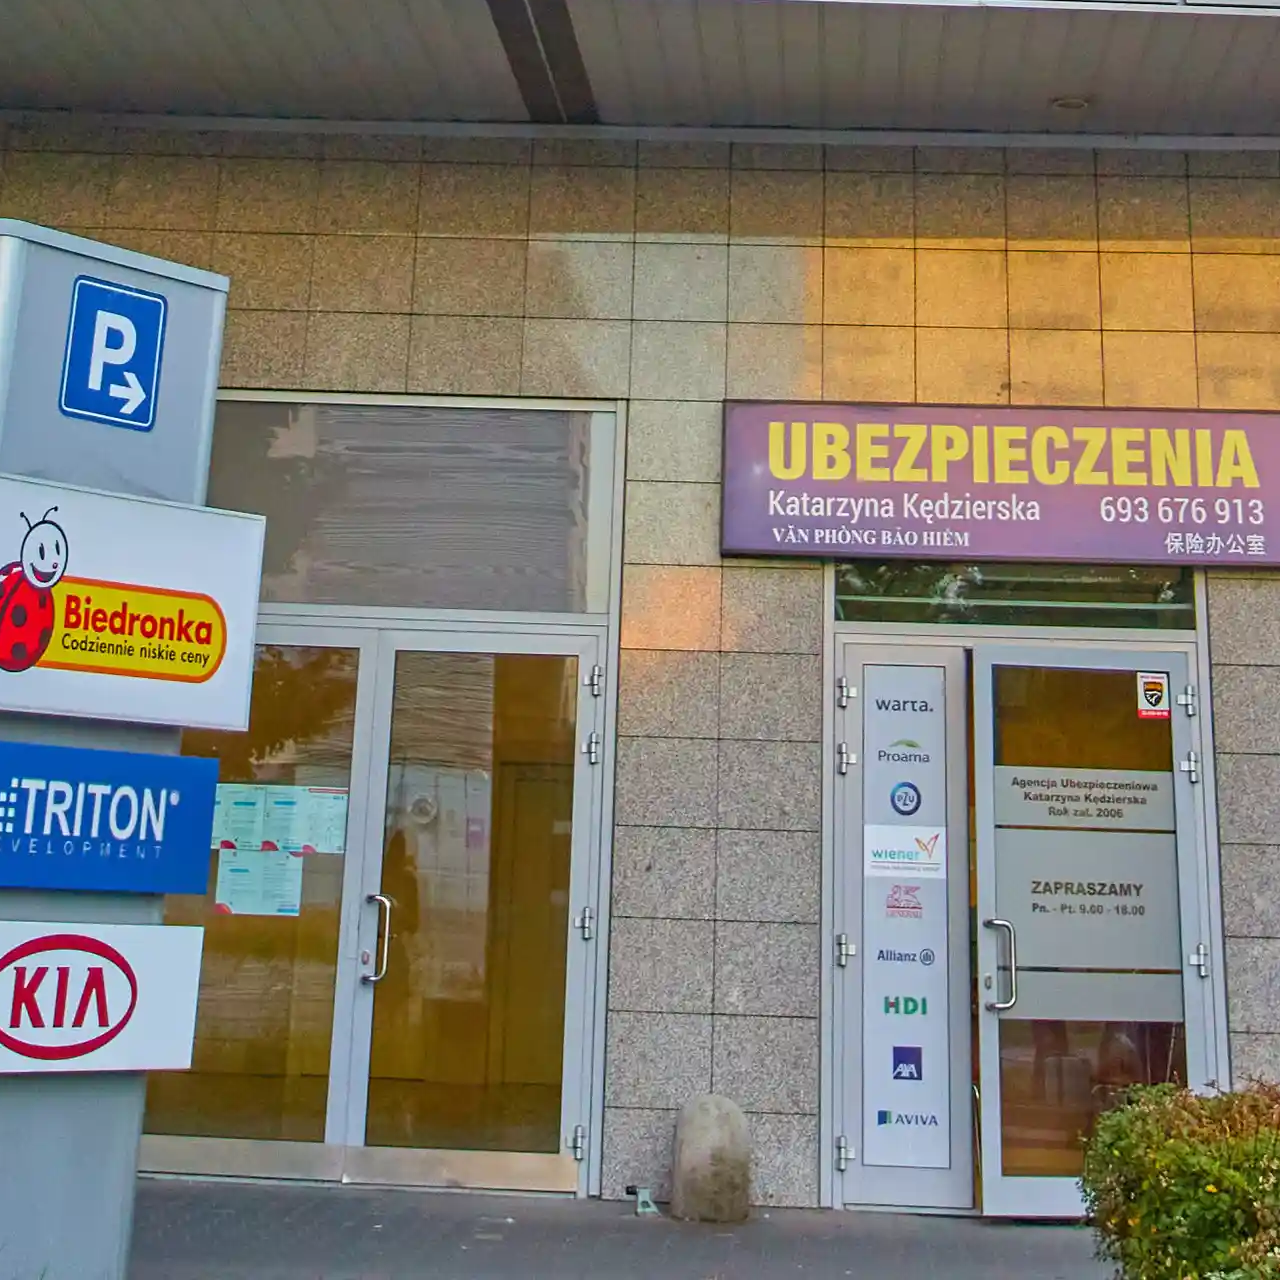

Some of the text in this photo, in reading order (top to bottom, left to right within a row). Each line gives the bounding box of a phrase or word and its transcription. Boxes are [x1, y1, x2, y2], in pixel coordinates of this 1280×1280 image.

[88, 309, 138, 392] P
[767, 421, 1260, 488] UBEZPIECZENIA
[767, 489, 1041, 524] Katarzyna Kędzierska
[1100, 496, 1265, 525] 693 676 913
[814, 525, 877, 545] PHÒNG
[1164, 532, 1267, 555] 保险办公室
[63, 593, 213, 646] Biedronka
[61, 632, 210, 669] Codziennie niskie ceny
[1011, 776, 1159, 792] Agencja Ubezpieczeniowa
[1023, 792, 1148, 806] Katarzyna Kędzierska
[21, 777, 168, 843] TRITON
[1048, 806, 1069, 817] Rok
[1030, 880, 1144, 897] ZAPRASZAMY
[876, 949, 917, 963] Allianz
[9, 966, 110, 1029] KIA
[883, 996, 928, 1016] HDI
[893, 1062, 918, 1078] AXA
[894, 1111, 939, 1127] AVIVA
